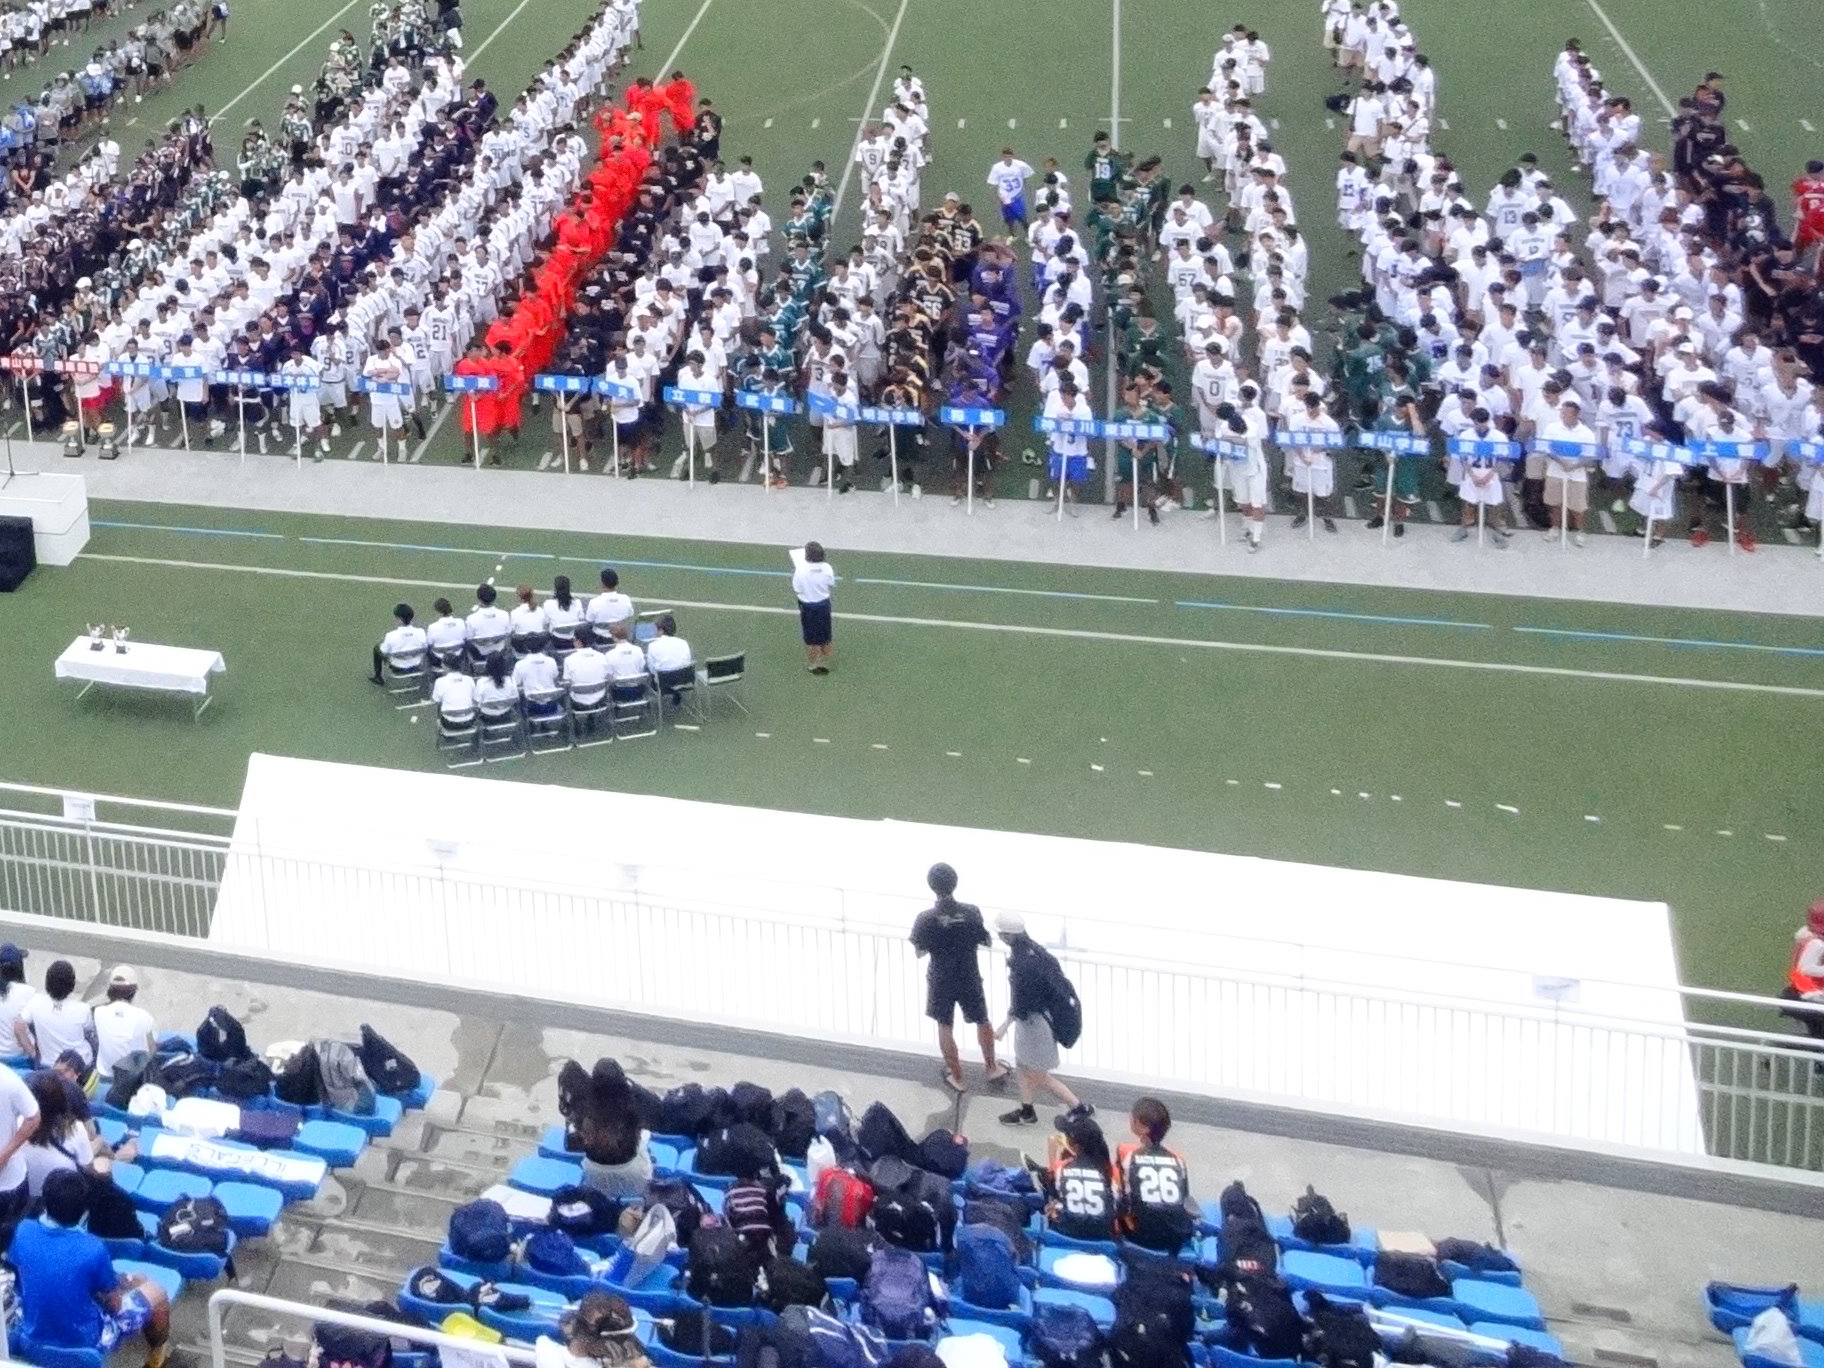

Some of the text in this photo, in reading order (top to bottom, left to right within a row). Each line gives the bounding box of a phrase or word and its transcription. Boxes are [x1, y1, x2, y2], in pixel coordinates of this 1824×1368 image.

[432, 324, 447, 341] 21
[1064, 1178, 1106, 1217] 25
[1137, 1165, 1180, 1206] 26
